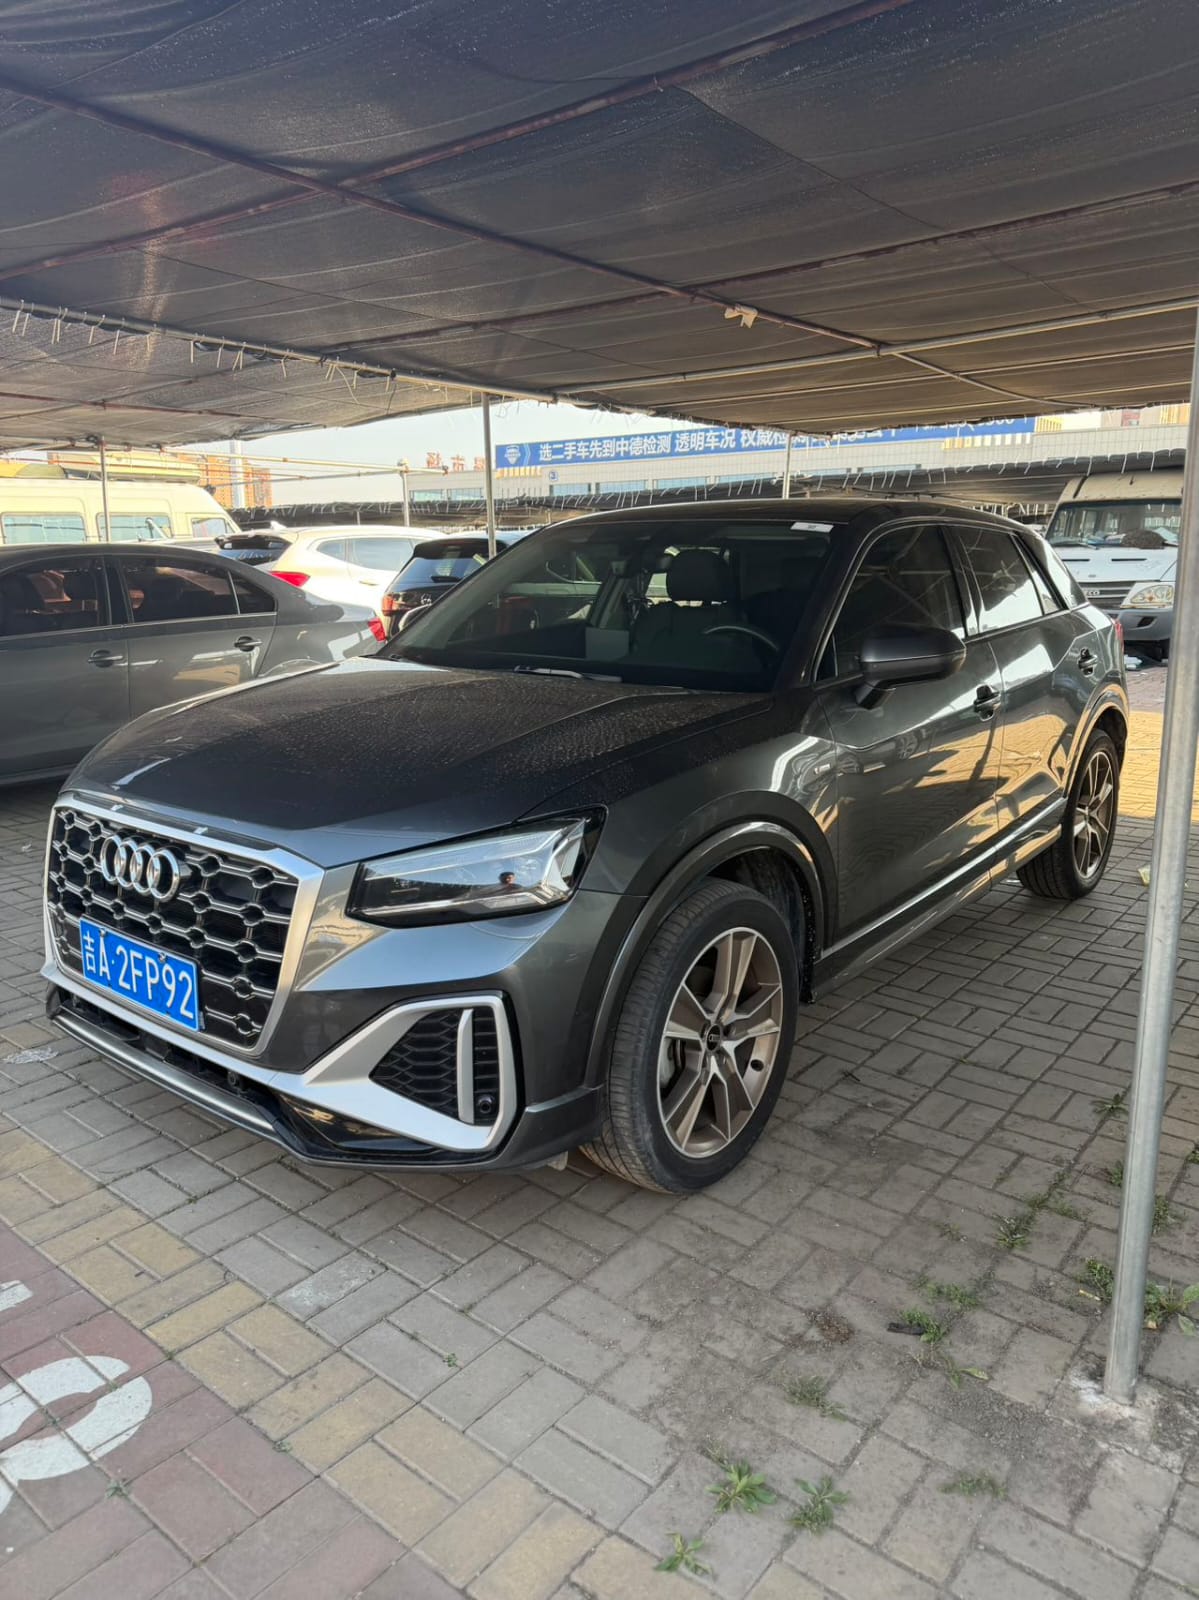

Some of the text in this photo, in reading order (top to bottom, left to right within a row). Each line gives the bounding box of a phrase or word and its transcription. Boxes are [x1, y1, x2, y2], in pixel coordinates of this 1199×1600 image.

[539, 434, 672, 461] 选二手车先到中德检测
[675, 429, 736, 452] 透明车况
